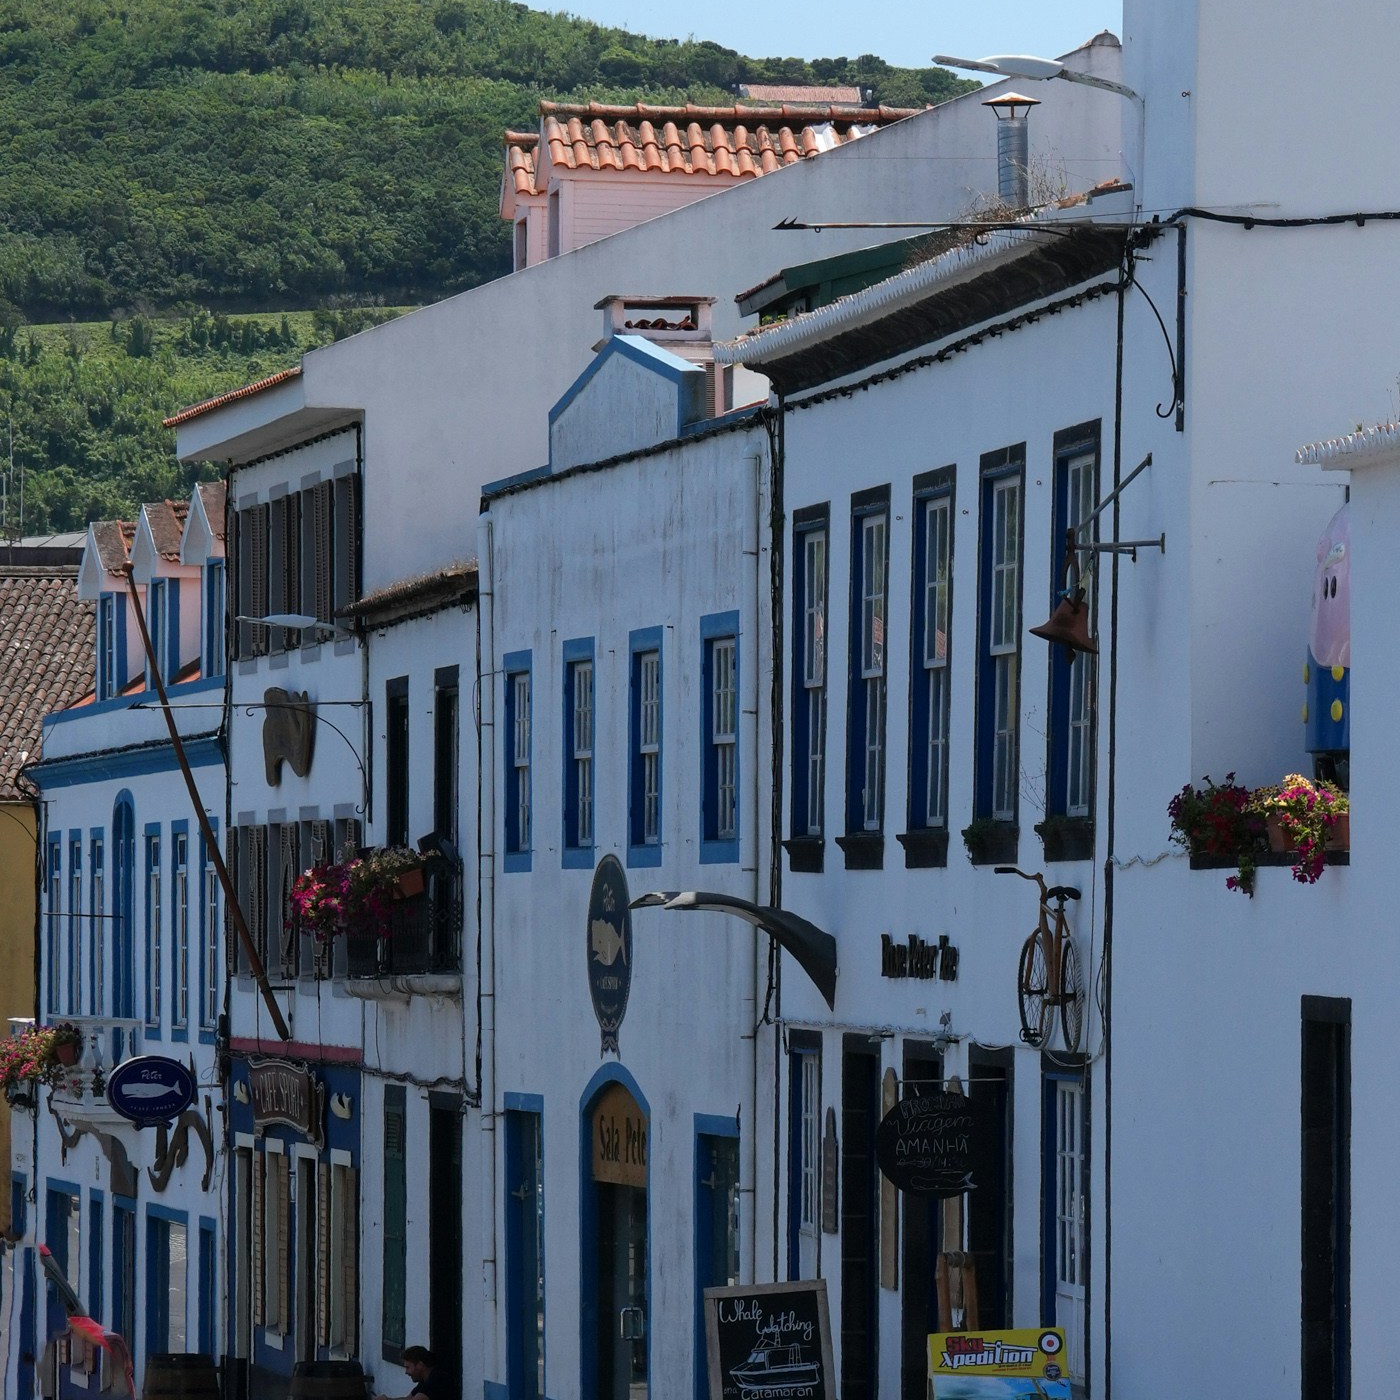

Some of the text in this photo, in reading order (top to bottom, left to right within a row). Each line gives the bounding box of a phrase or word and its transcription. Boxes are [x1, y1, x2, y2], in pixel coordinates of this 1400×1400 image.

[599, 1114, 647, 1166] Sala Pete
[895, 1133, 970, 1156] AMANHÃ
[718, 1299, 763, 1324] Whale
[756, 1310, 816, 1342] Watching
